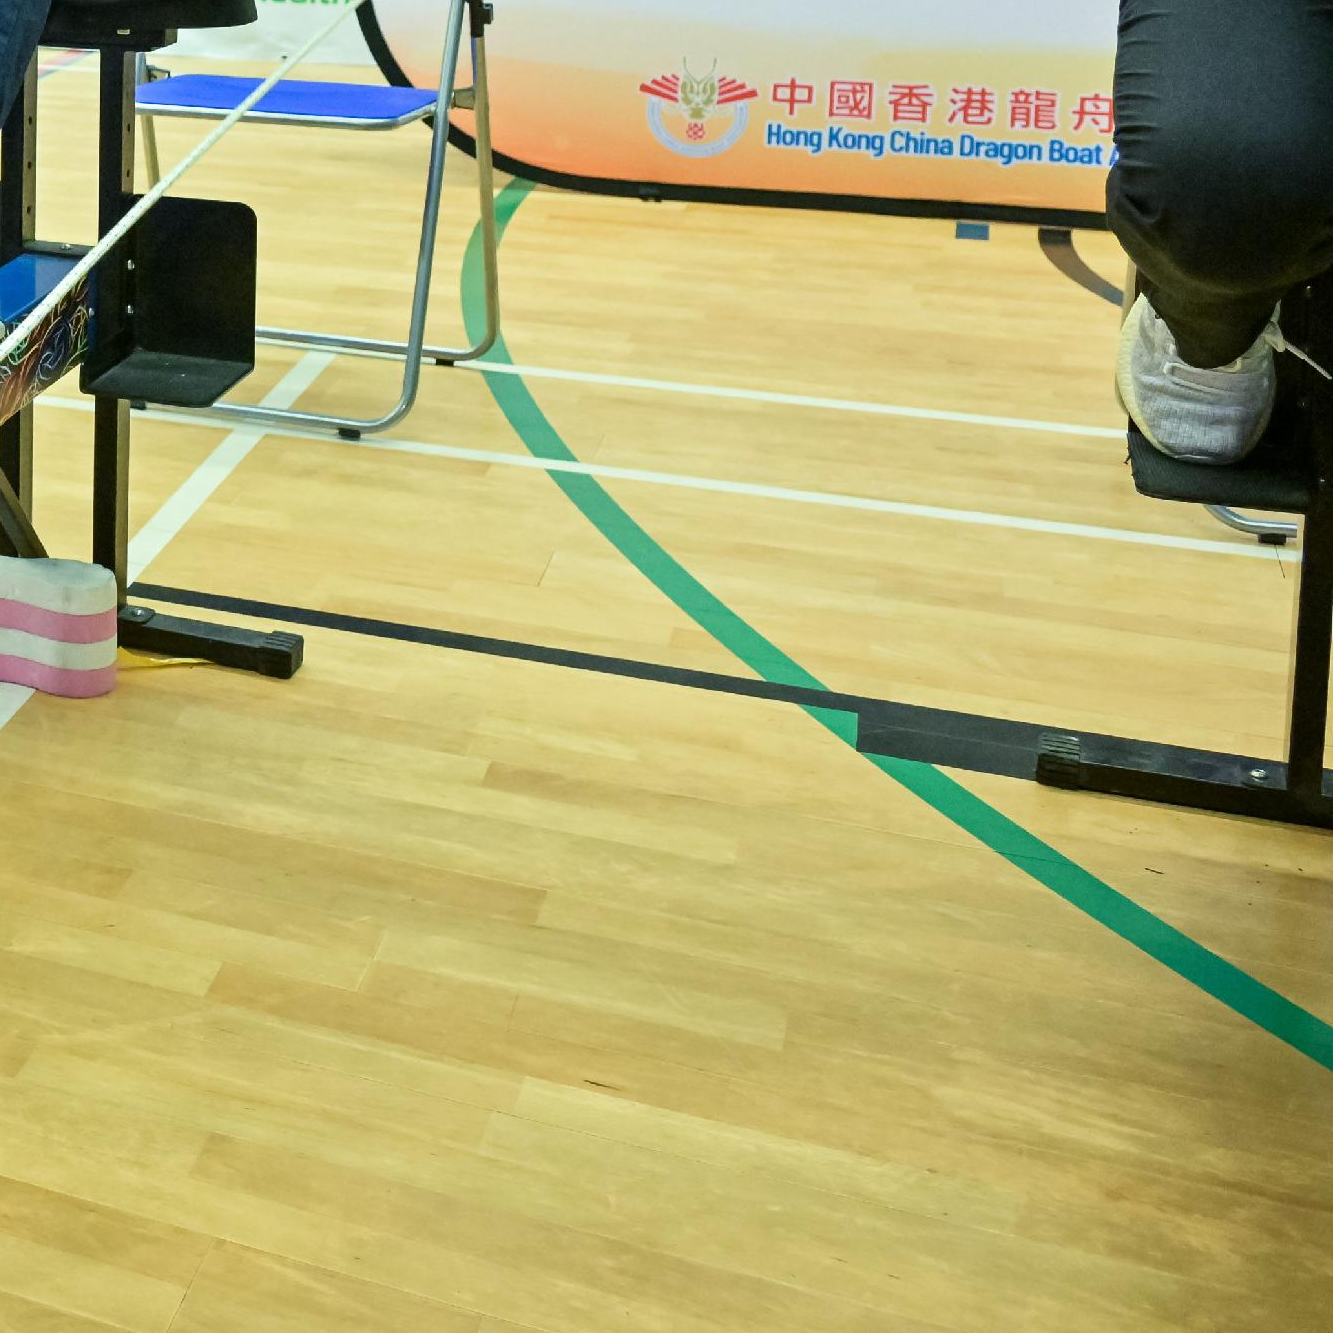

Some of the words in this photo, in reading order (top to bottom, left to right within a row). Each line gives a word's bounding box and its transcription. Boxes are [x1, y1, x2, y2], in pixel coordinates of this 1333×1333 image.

[767, 123, 822, 153] Hong
[828, 127, 884, 157] Kong
[890, 131, 953, 156] China
[960, 138, 1043, 165] Dragon
[1048, 140, 1103, 164] Boat
